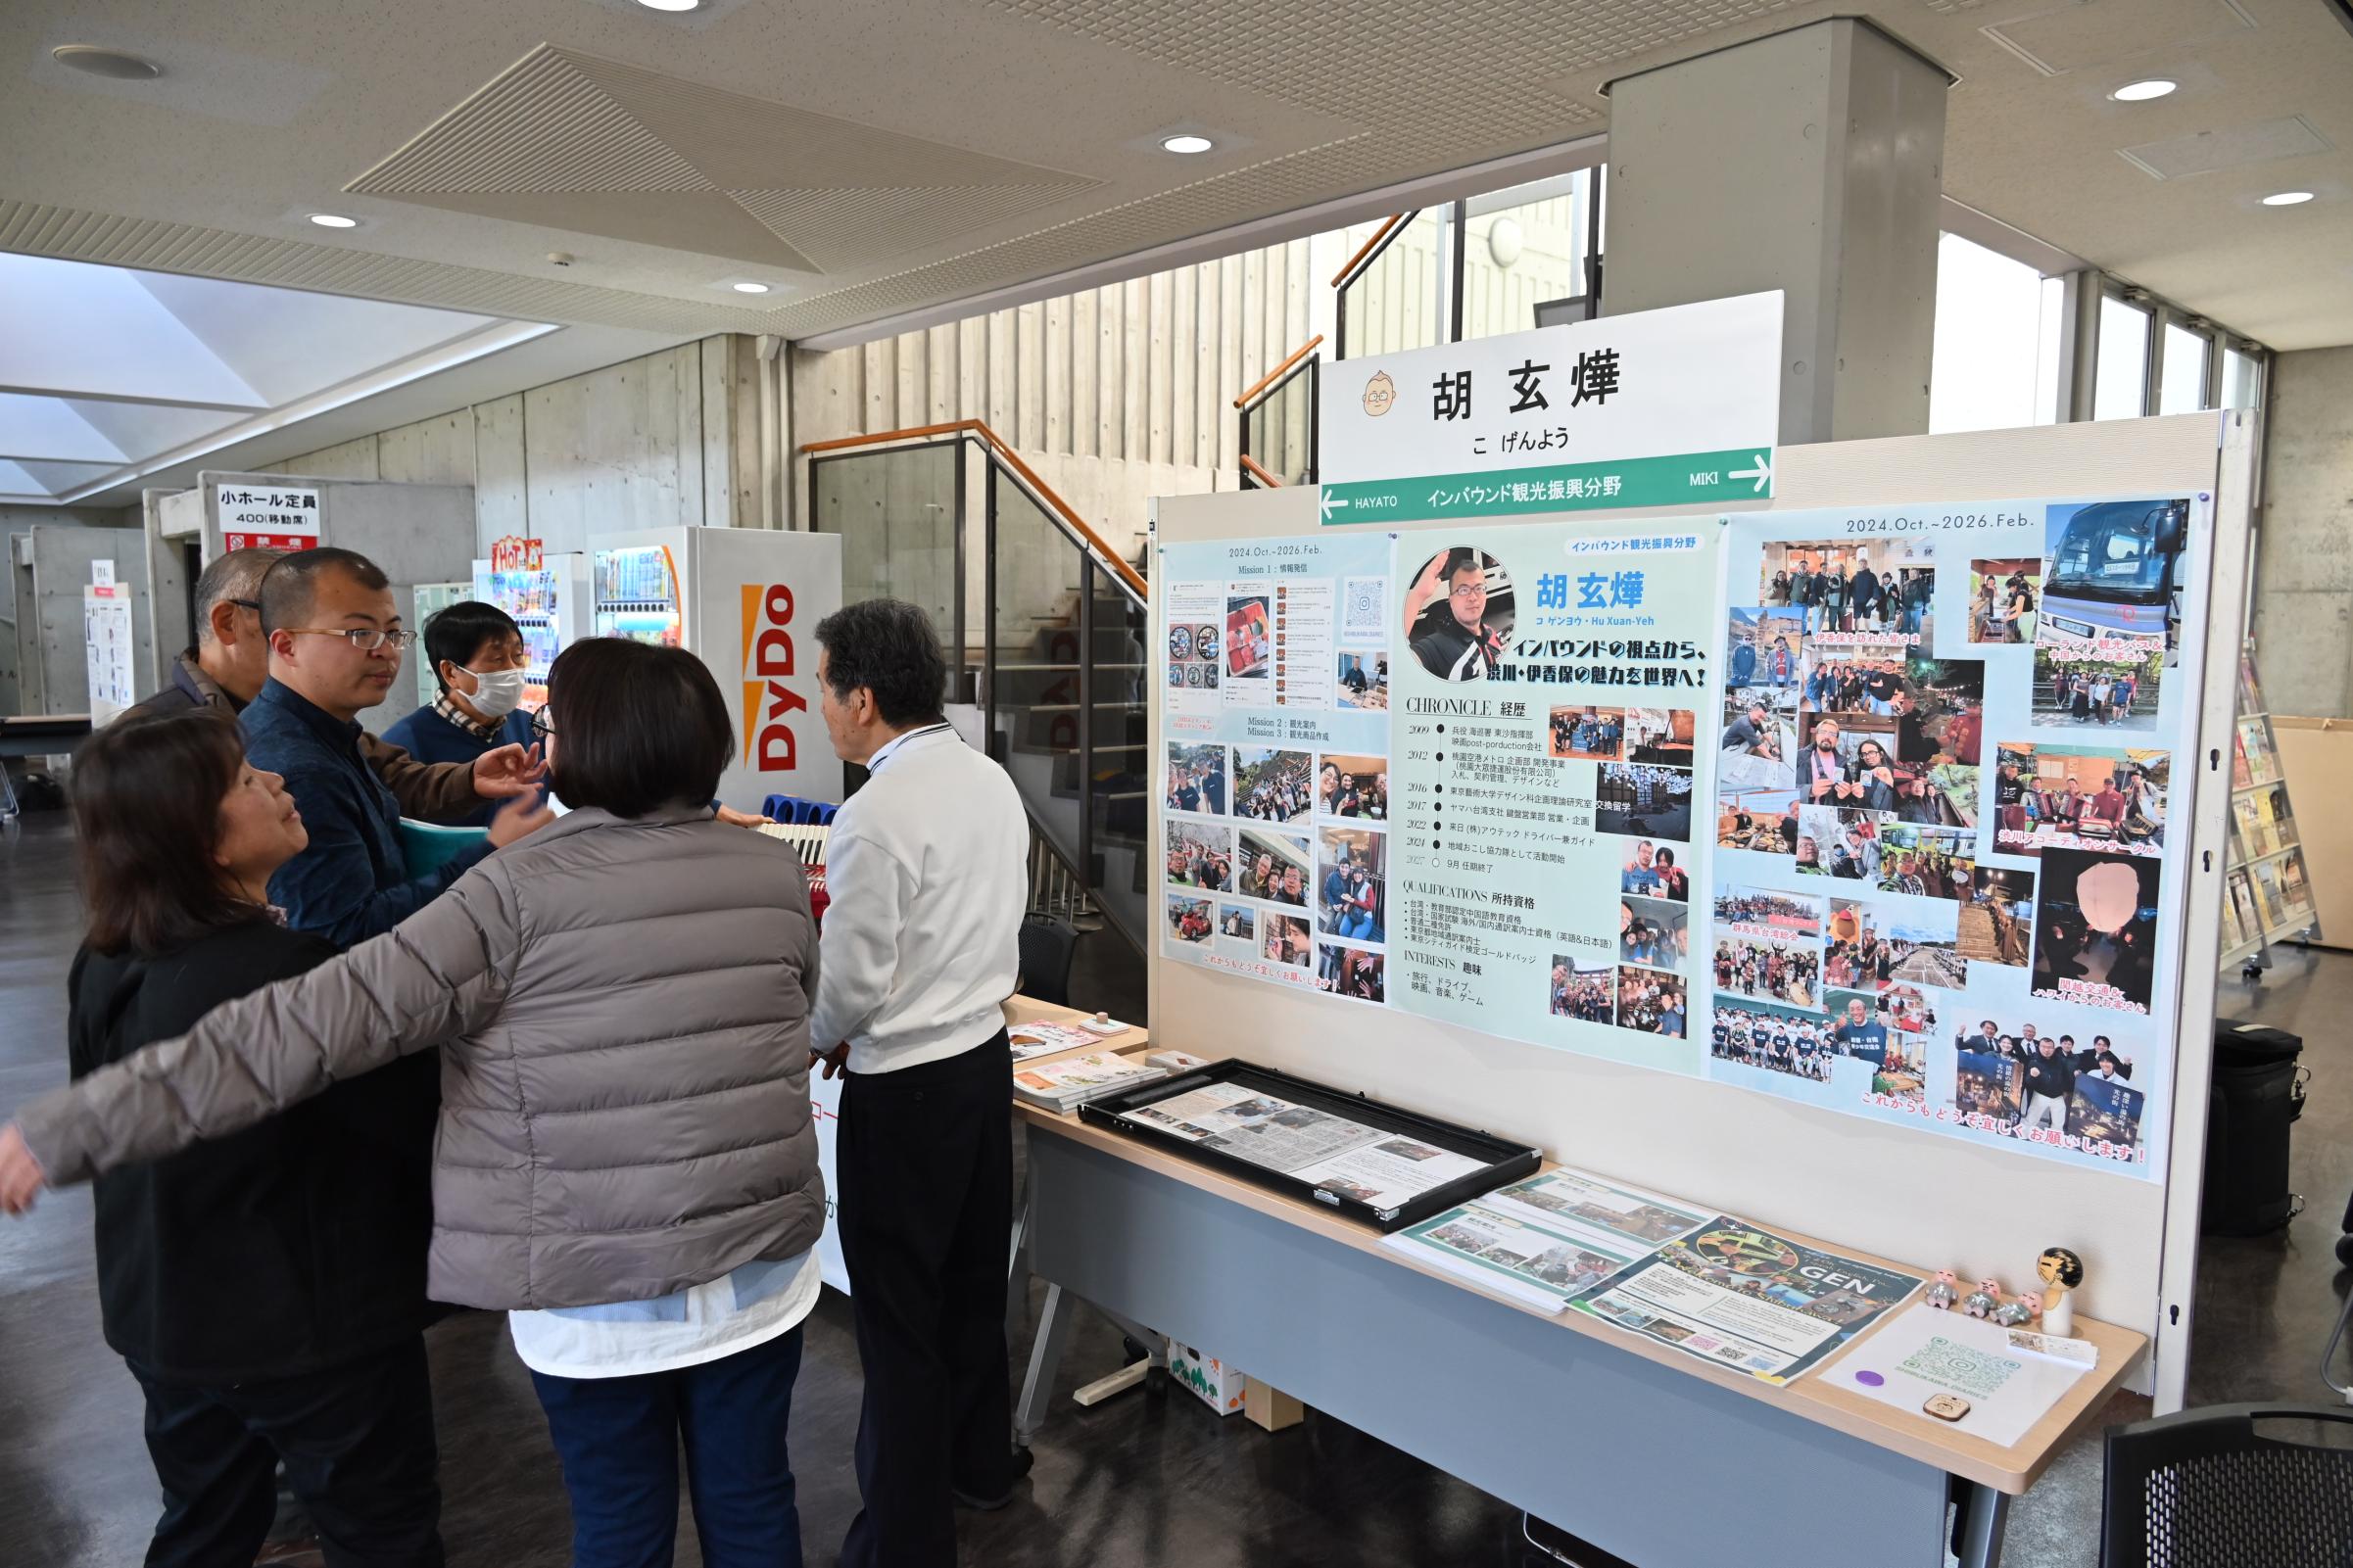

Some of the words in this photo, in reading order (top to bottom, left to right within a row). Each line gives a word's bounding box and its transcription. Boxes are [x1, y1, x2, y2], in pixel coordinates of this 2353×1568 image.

[1501, 426, 1569, 451] げんよう
[1690, 472, 1719, 487] MIKI
[221, 491, 316, 509] 小ホール定員
[1427, 475, 1622, 508] インバウンド観光振興分野
[1355, 496, 1398, 509] HAYATO
[1571, 537, 1697, 552] インバウンド観光振興分野
[1607, 616, 1655, 627] Xuan-Yeh
[1513, 640, 1706, 660] インバウンドの視点から、
[1406, 697, 1492, 716] CHRONICLE
[1500, 701, 1526, 717] 経歴
[1447, 859, 1460, 870] 9月
[1462, 861, 1494, 874] 任期終了
[1403, 879, 1488, 903] QUALIFICATIONS
[1491, 892, 1535, 910] 所持資格
[1404, 950, 1456, 971] INTERESTS
[1463, 962, 1483, 976] 趣味
[1800, 1266, 1876, 1295] GEN
